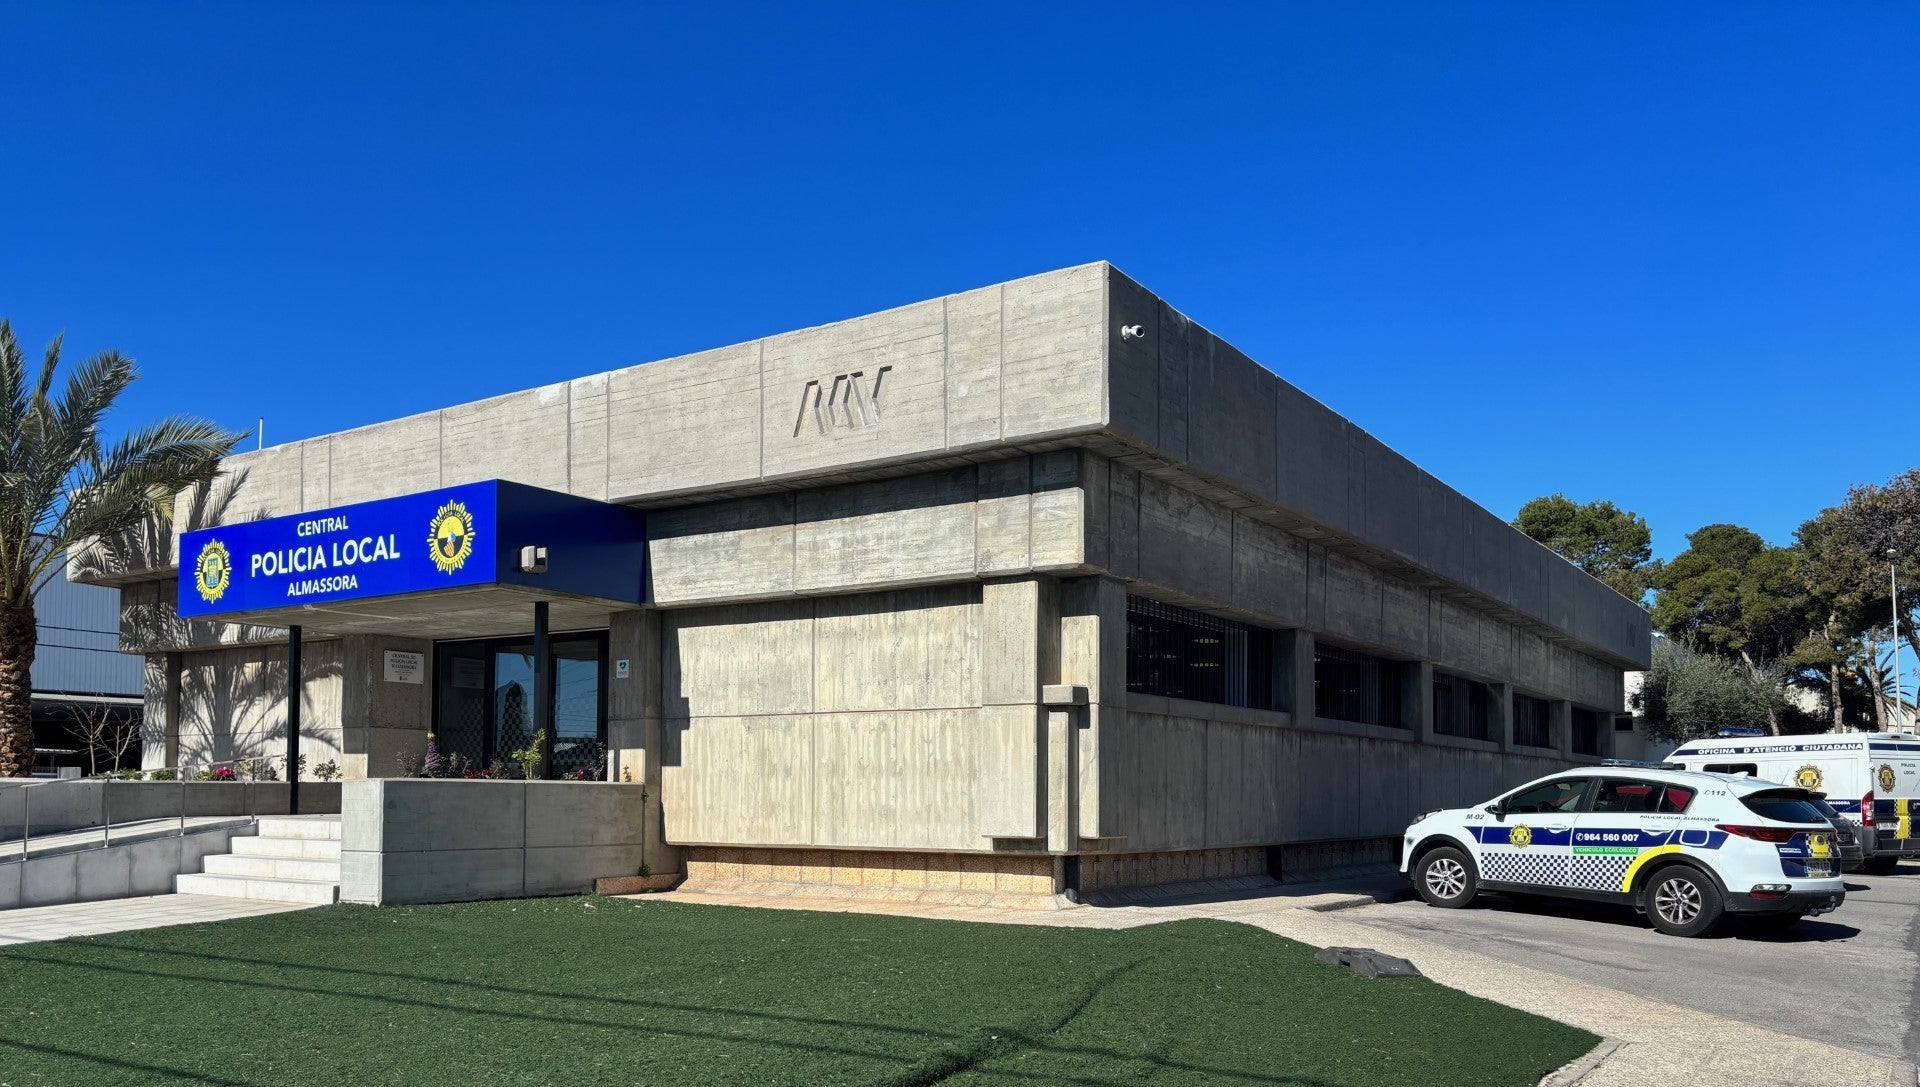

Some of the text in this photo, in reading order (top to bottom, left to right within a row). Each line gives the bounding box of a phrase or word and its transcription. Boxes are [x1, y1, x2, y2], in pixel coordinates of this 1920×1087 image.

[297, 515, 349, 537] CENTRAL
[251, 533, 401, 578] POLICIA LOCAL
[286, 574, 359, 597] ALMASSORA
[1743, 745, 1797, 754] D'ATENCIÓ
[1802, 743, 1863, 751] CIUTADANA
[1583, 833, 1640, 842] 964 560 007
